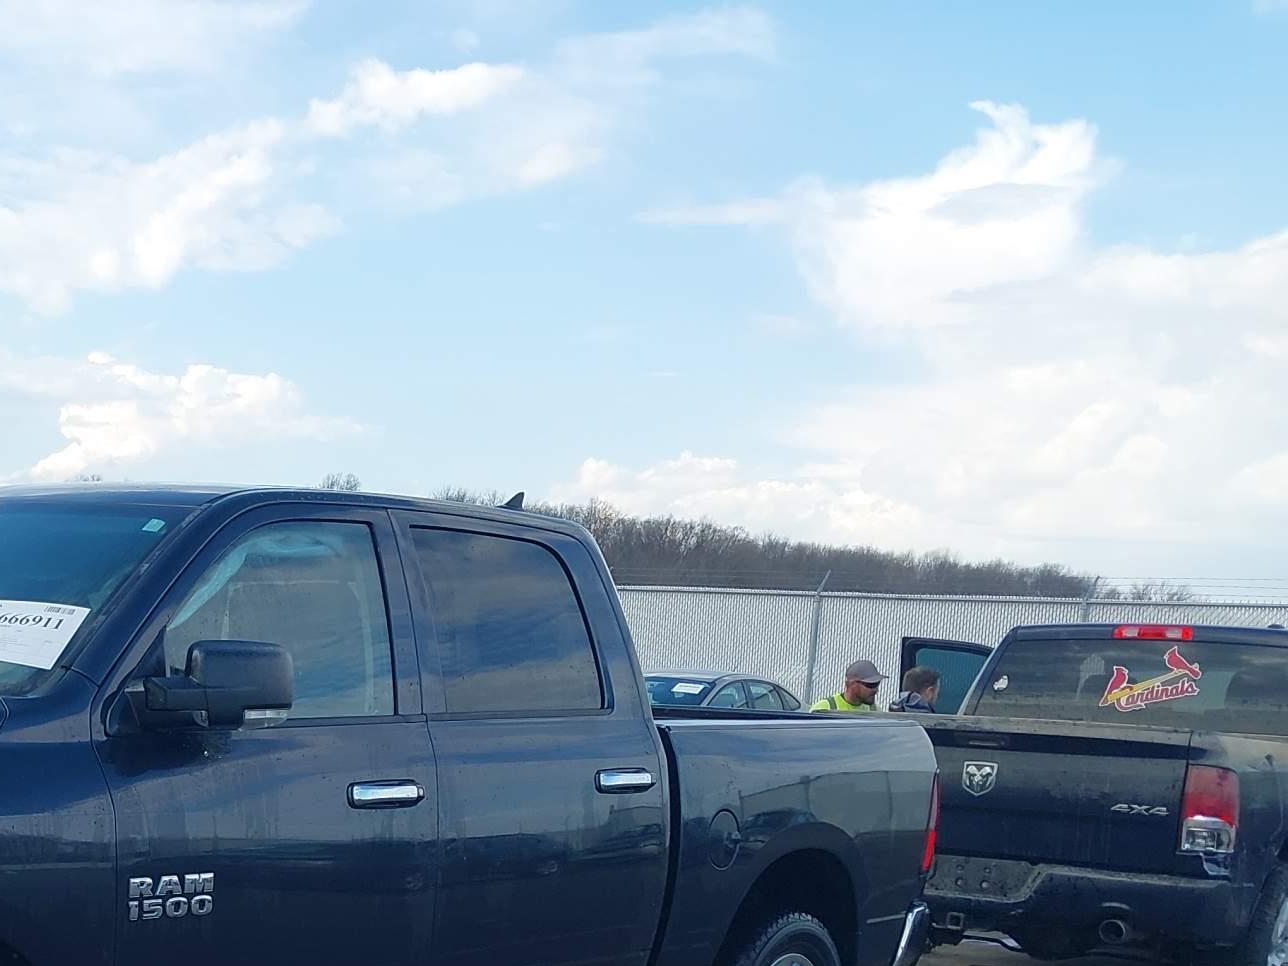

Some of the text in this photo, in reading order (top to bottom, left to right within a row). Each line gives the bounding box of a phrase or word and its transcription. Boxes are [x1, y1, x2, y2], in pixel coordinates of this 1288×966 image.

[1115, 677, 1200, 712] Cardinals
[129, 873, 214, 898] RAM
[128, 895, 213, 920] 1500
